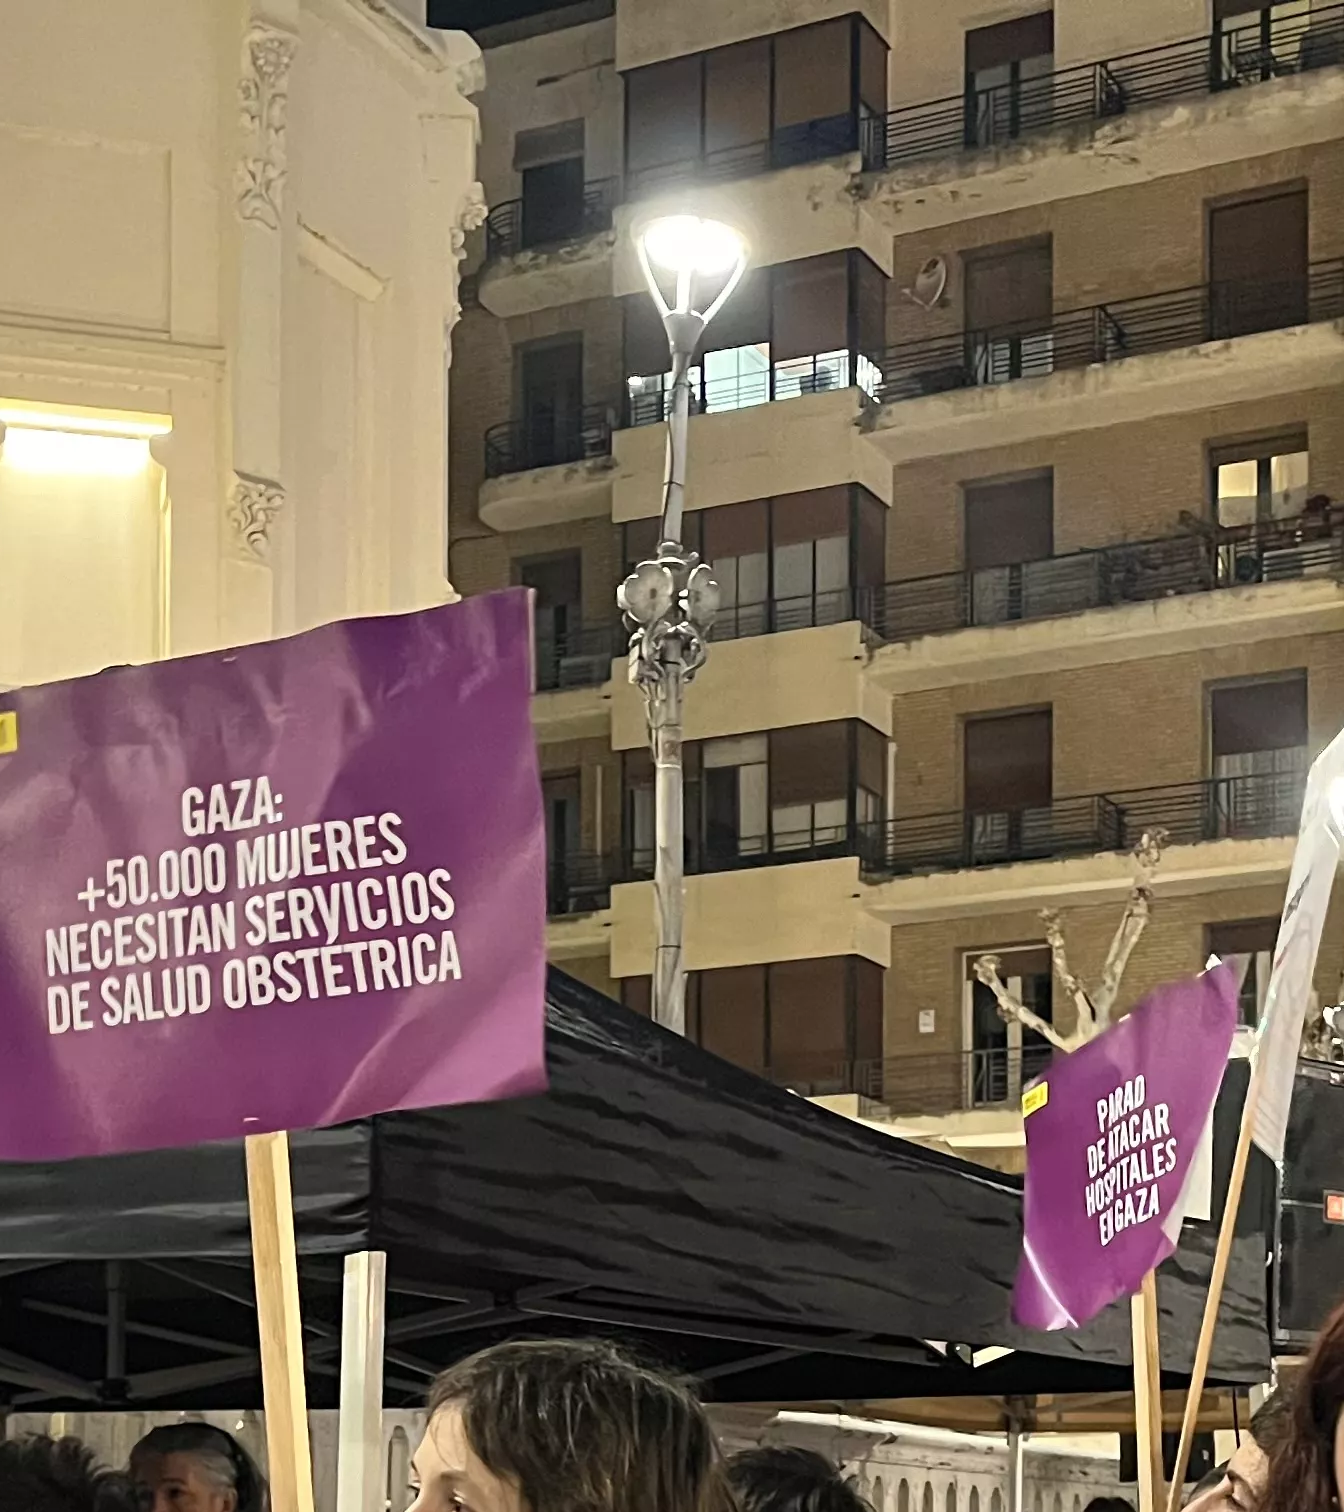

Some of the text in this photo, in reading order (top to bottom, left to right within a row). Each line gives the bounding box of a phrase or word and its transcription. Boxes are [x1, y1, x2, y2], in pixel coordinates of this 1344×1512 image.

[181, 775, 284, 837] GAZA:
[77, 812, 408, 913] +50.000 MUJERES
[45, 868, 456, 977] NECESITAN SERVICIOS
[47, 980, 94, 1036] DE
[100, 964, 212, 1028] SALUD
[1086, 1102, 1171, 1179] DE ATACAR
[1096, 1074, 1146, 1133] PARAD
[1085, 1137, 1178, 1218] HOSPITALES
[1114, 1183, 1160, 1233] GAZA
